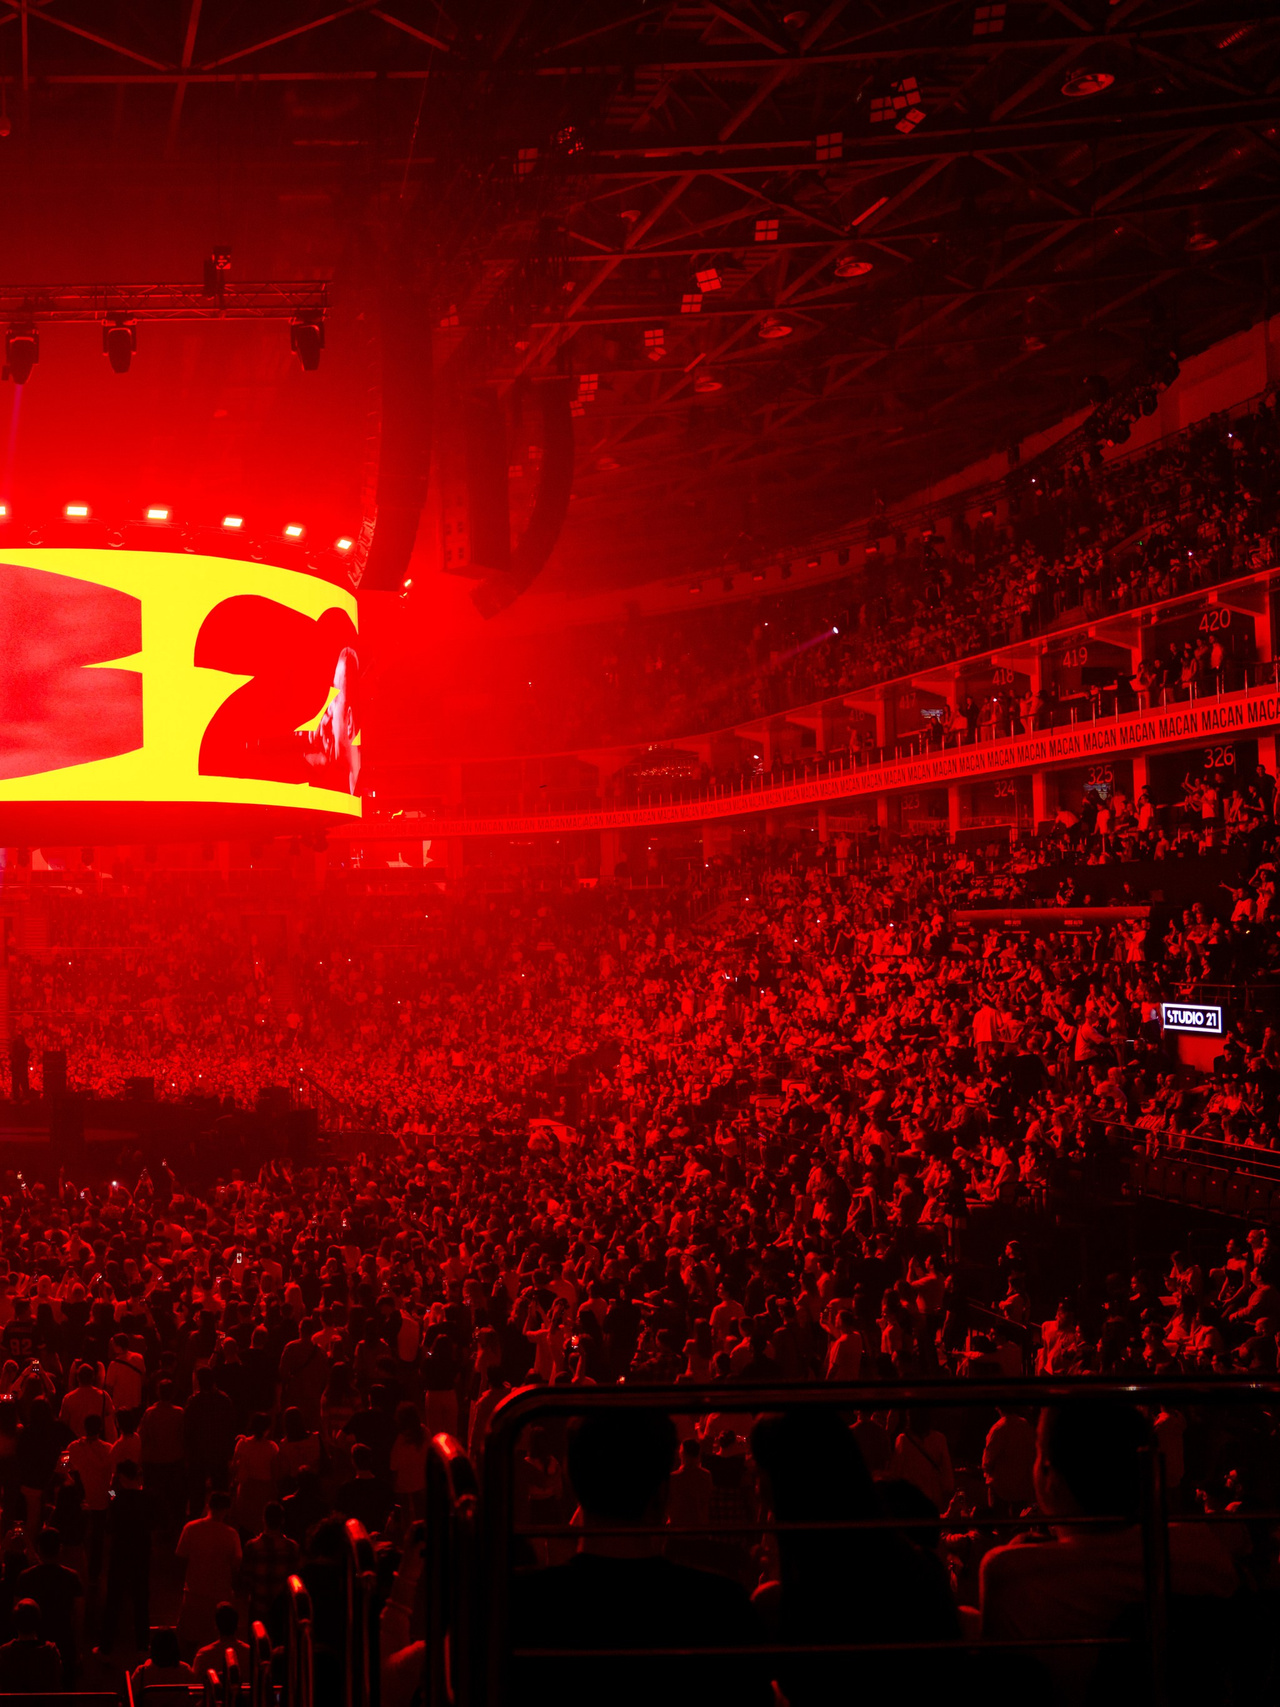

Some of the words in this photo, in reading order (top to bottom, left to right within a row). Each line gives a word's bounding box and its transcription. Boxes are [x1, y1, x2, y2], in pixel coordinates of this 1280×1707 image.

[1198, 608, 1231, 633] 420
[1063, 646, 1088, 668] 419
[992, 669, 1014, 686] 418
[932, 758, 957, 777] MACAN
[959, 753, 984, 773] MACAN
[987, 747, 1014, 768] MACAN
[1017, 741, 1046, 762] MACAN
[1048, 736, 1080, 756] MACAN
[1083, 729, 1116, 751] MACAN
[1119, 721, 1155, 746] MACAN
[1158, 713, 1197, 739] MACAN
[1201, 704, 1243, 732] MACAN
[1204, 745, 1234, 768] 326
[1087, 765, 1113, 785] 325
[994, 780, 1015, 798] 324
[1167, 1010, 1204, 1026] STUDIO
[1206, 1012, 1217, 1027] 21
